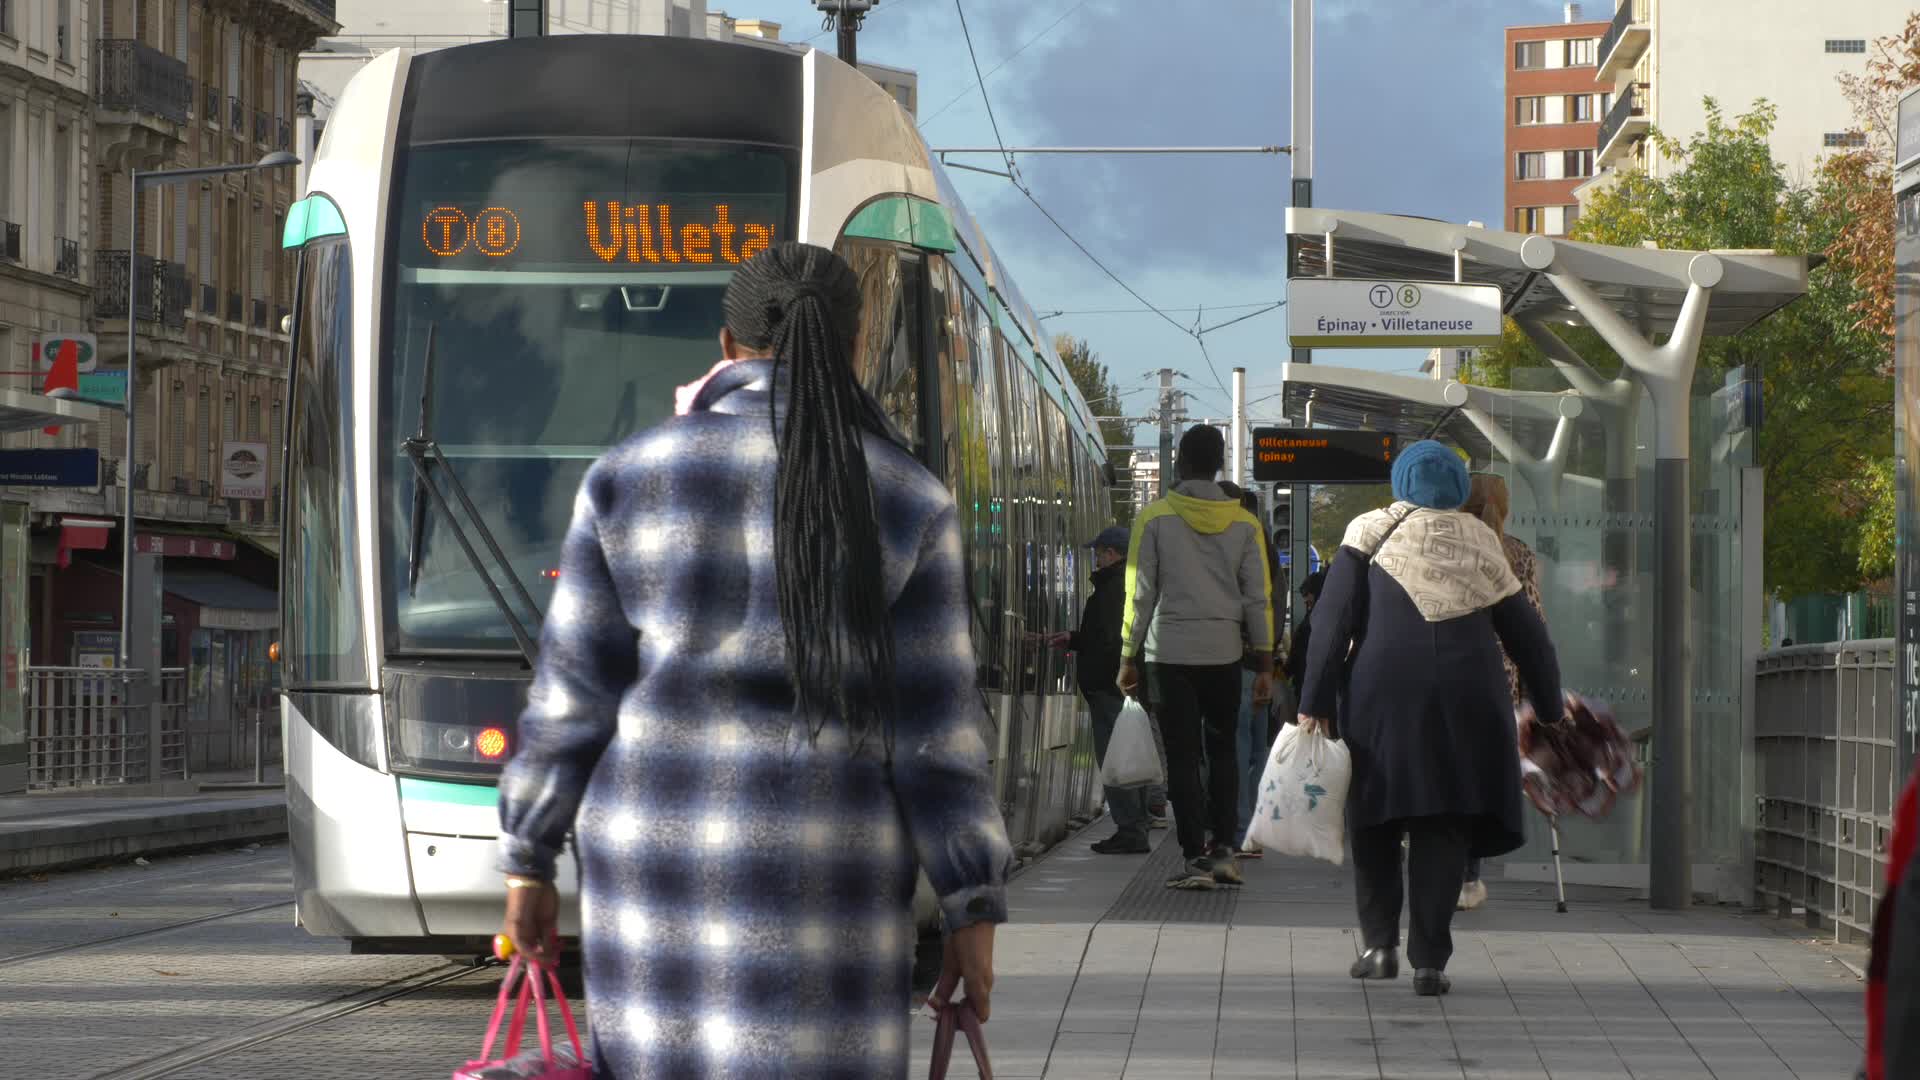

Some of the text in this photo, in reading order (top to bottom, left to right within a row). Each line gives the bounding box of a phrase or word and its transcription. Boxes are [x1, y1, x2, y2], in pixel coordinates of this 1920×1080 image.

[435, 200, 774, 263] T 8 Villeta
[1376, 289, 1414, 304] T 8
[1317, 315, 1473, 334] Épinay Villetaneuse
